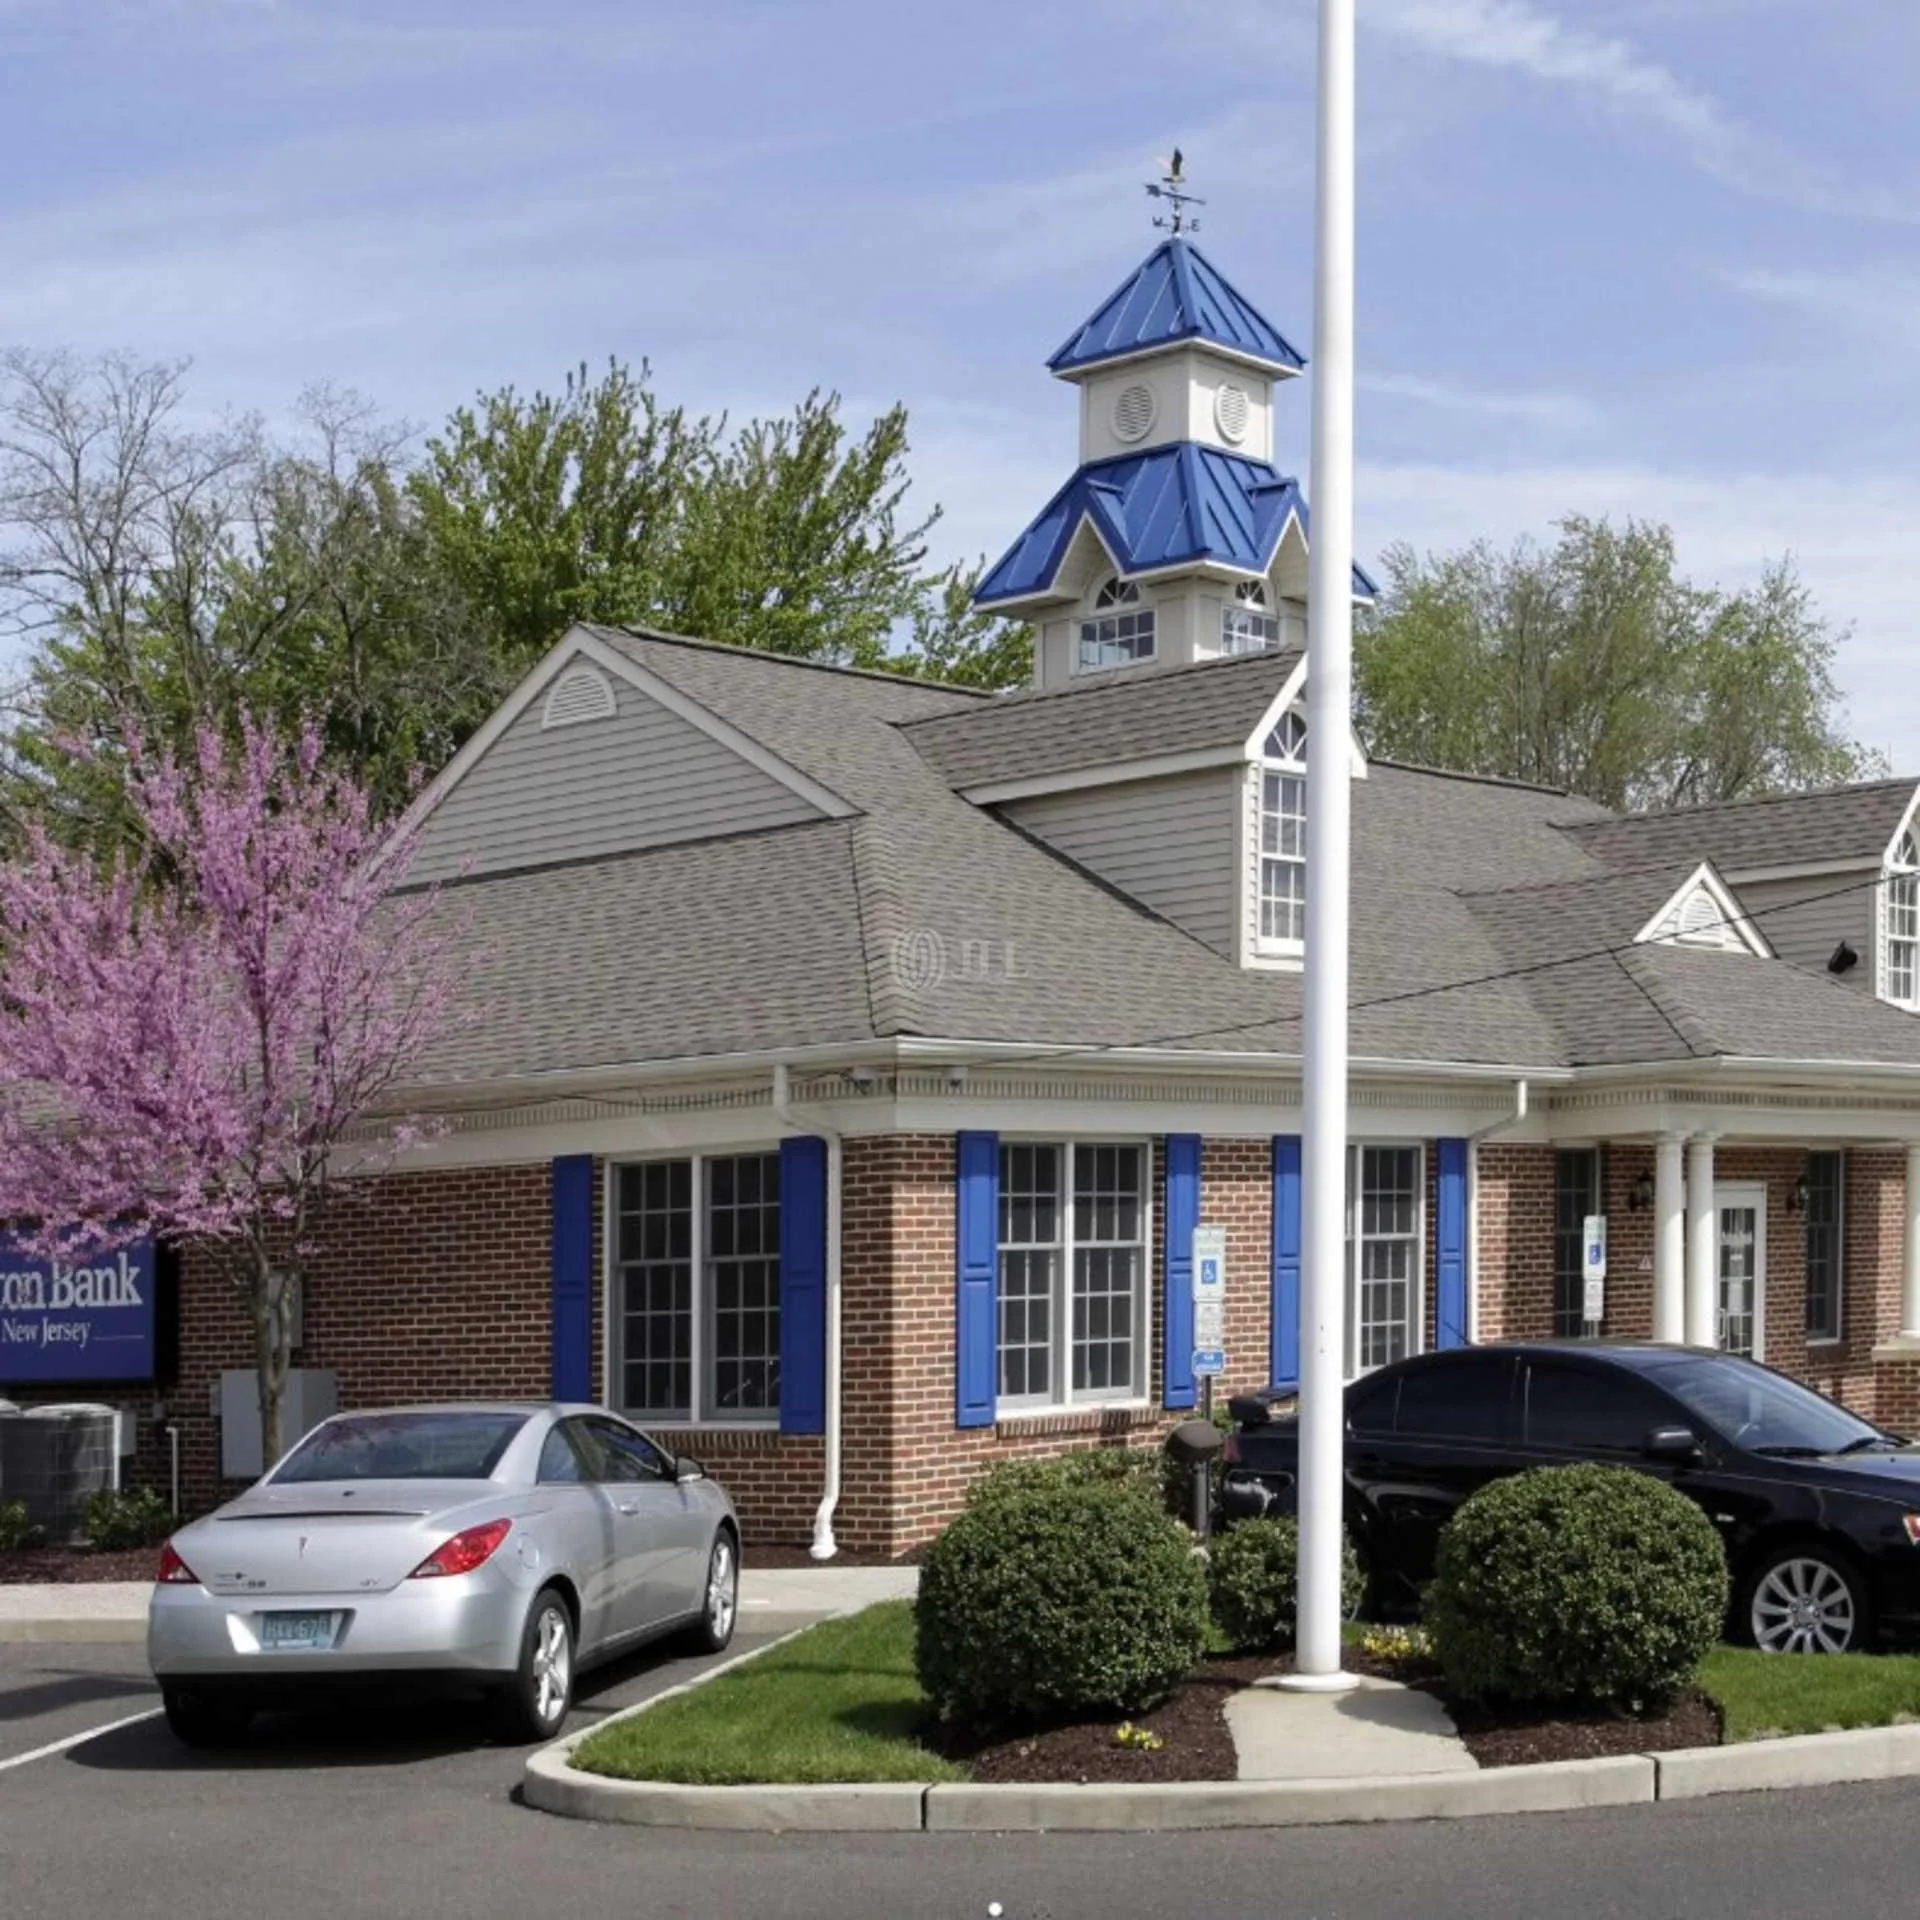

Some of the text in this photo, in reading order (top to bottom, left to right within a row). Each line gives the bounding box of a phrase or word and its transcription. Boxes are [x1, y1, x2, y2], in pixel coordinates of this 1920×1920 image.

[49, 1252, 144, 1309] Bank
[2, 1316, 92, 1349] New Jersey
